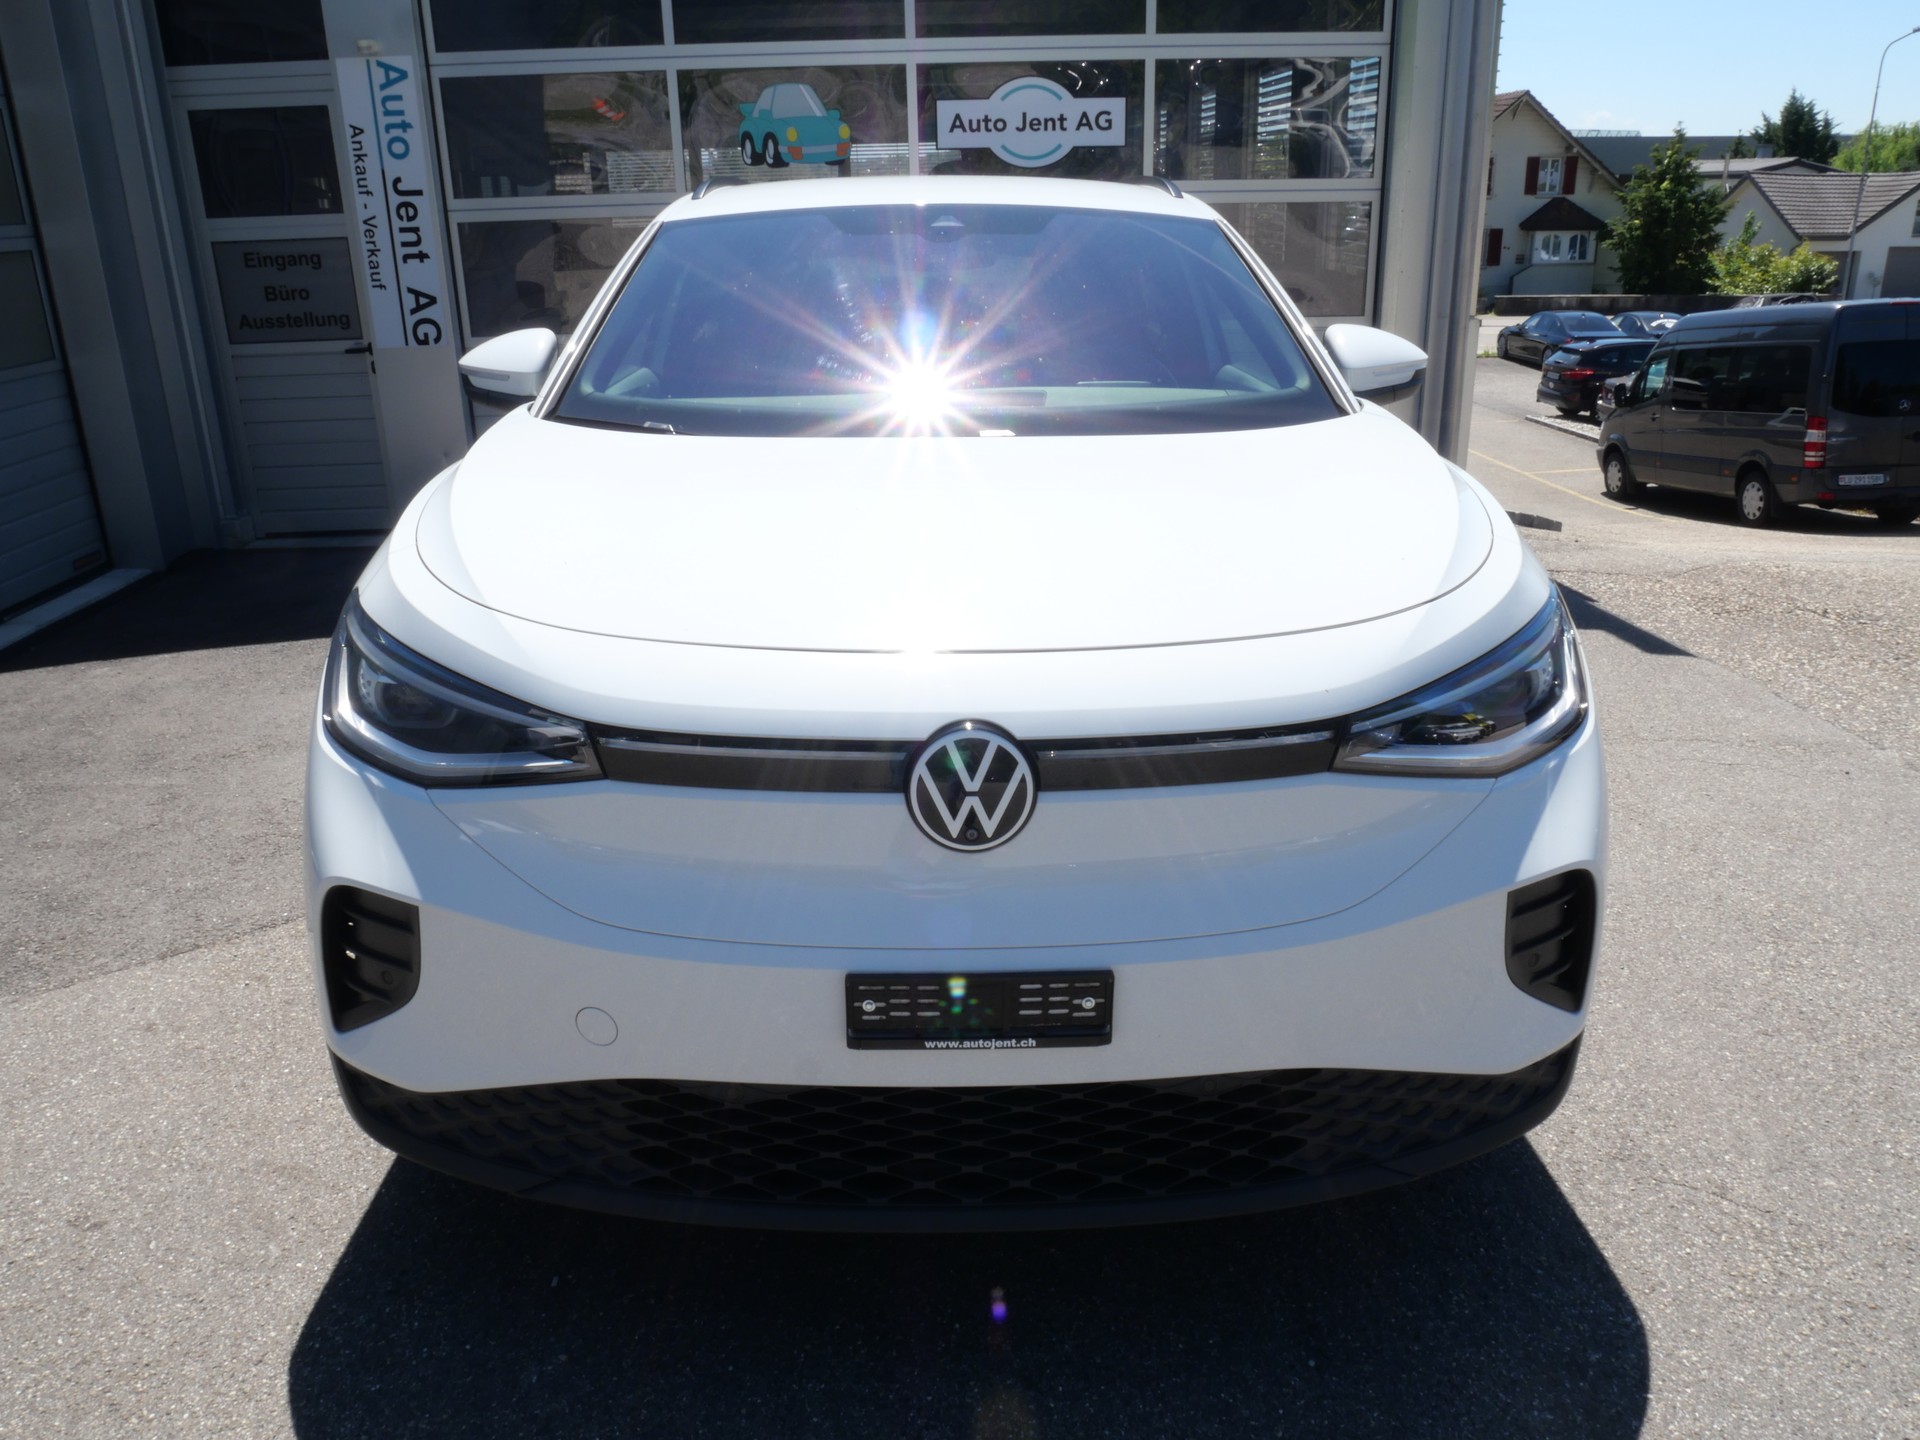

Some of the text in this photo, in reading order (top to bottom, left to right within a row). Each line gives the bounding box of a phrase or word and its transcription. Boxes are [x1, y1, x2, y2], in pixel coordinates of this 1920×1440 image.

[949, 110, 1113, 133] Auto Jent AG
[349, 124, 373, 197] Ankauf
[362, 215, 387, 291] Verkauf
[376, 60, 442, 347] Auto Jent AG
[243, 252, 323, 272] Eingang
[264, 285, 310, 303] Büro
[239, 313, 351, 332] Ausstellung
[924, 1038, 1037, 1049] www.autojent.ch
